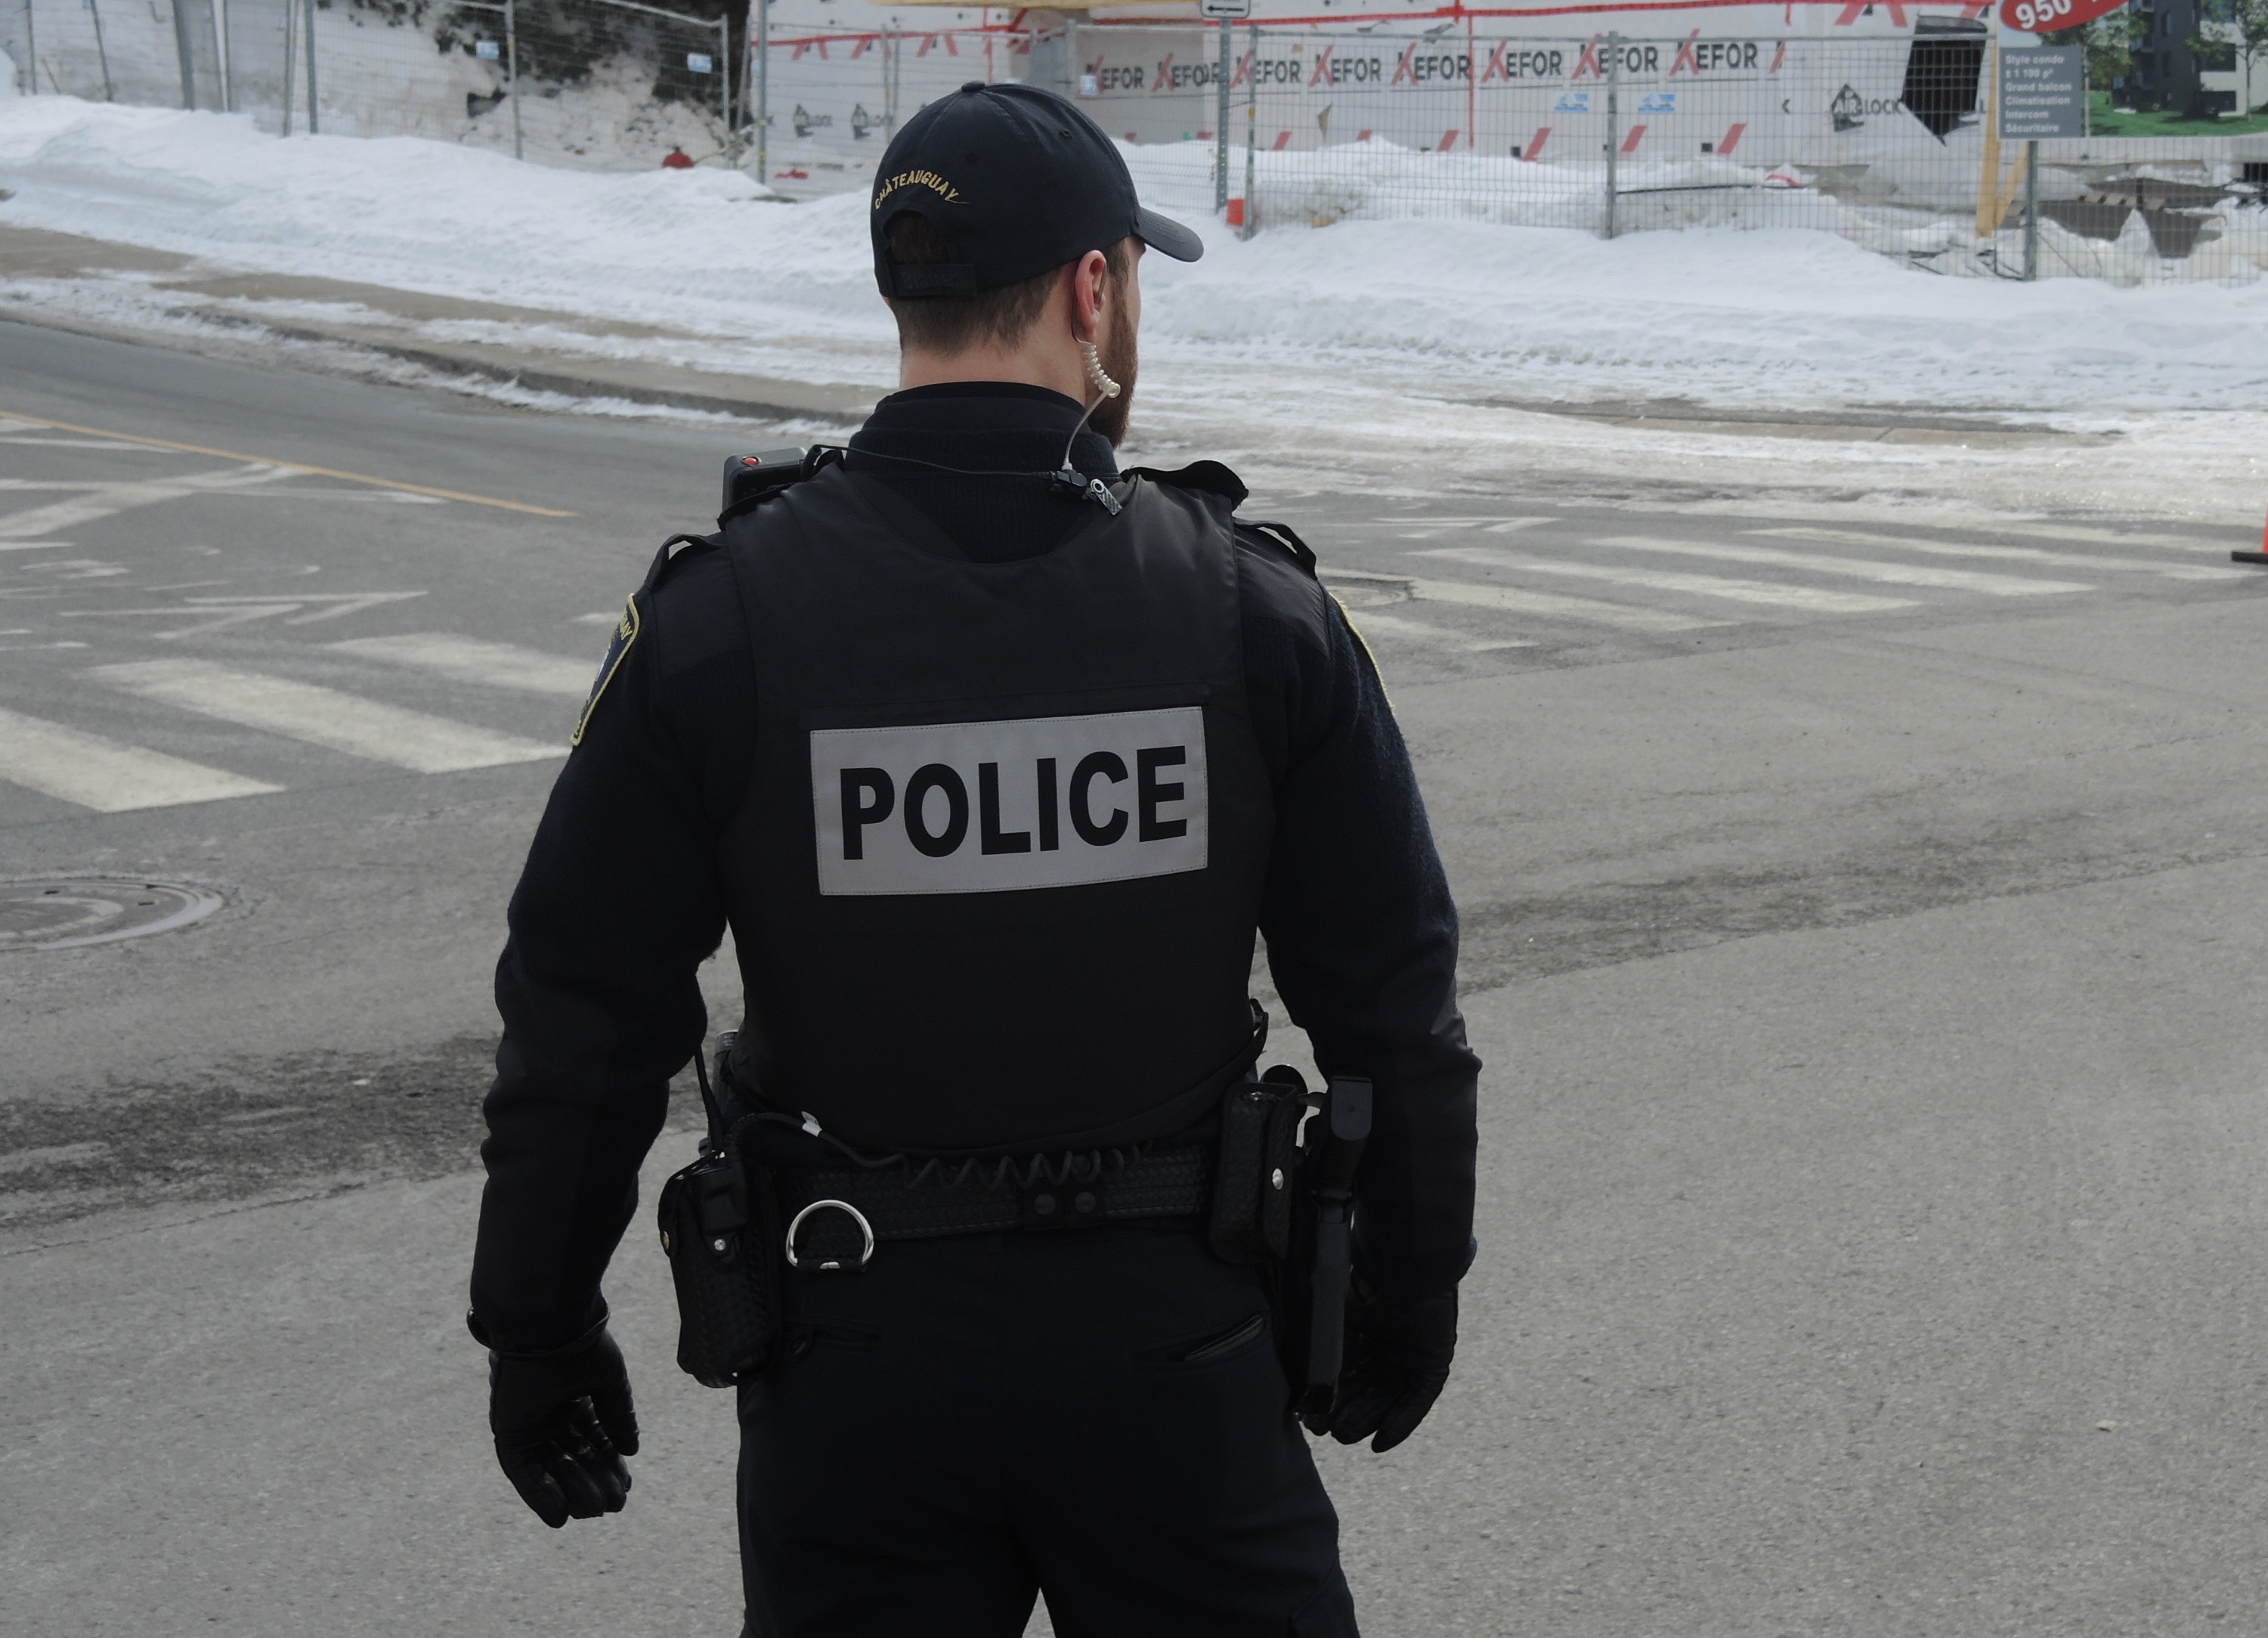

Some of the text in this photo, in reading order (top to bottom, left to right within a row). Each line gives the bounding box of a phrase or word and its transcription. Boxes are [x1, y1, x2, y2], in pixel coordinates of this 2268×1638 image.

[2016, 0, 2071, 29] 950
[2006, 55, 2064, 66] Style condo
[2006, 82, 2072, 91] Grand balcon
[2006, 96, 2071, 105] Climatisation
[2006, 110, 2049, 119] Intercom
[874, 170, 960, 209] CHÂTEAUGUAY
[840, 746, 1187, 859] POLICE
